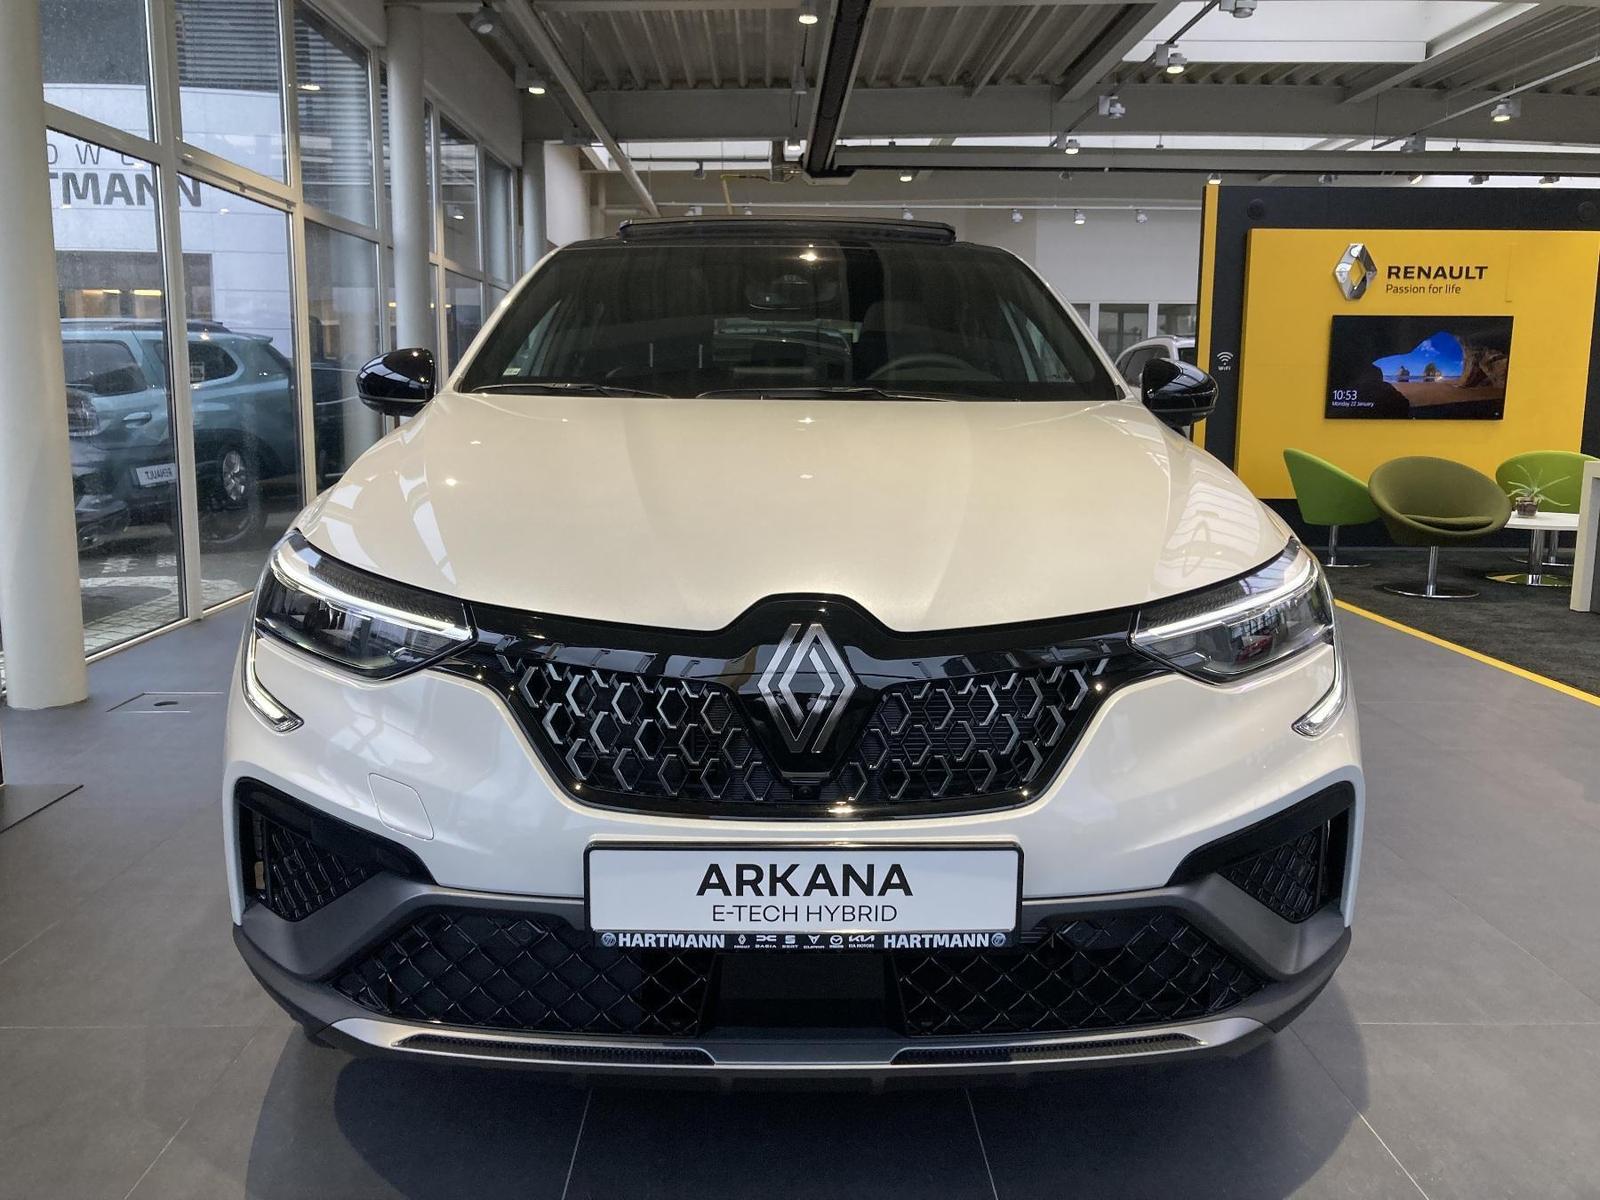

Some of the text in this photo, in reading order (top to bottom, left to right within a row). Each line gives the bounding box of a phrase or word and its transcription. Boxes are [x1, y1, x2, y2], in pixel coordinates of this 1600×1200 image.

[1387, 265, 1488, 280] RENAULT
[1386, 283, 1461, 295] Passion for life
[1332, 390, 1358, 401] 10:53
[696, 863, 914, 896] ARKANA
[712, 904, 898, 922] E-TECH HYBRID
[618, 933, 725, 948] HARTMANN
[884, 933, 989, 948] HARTMANN
